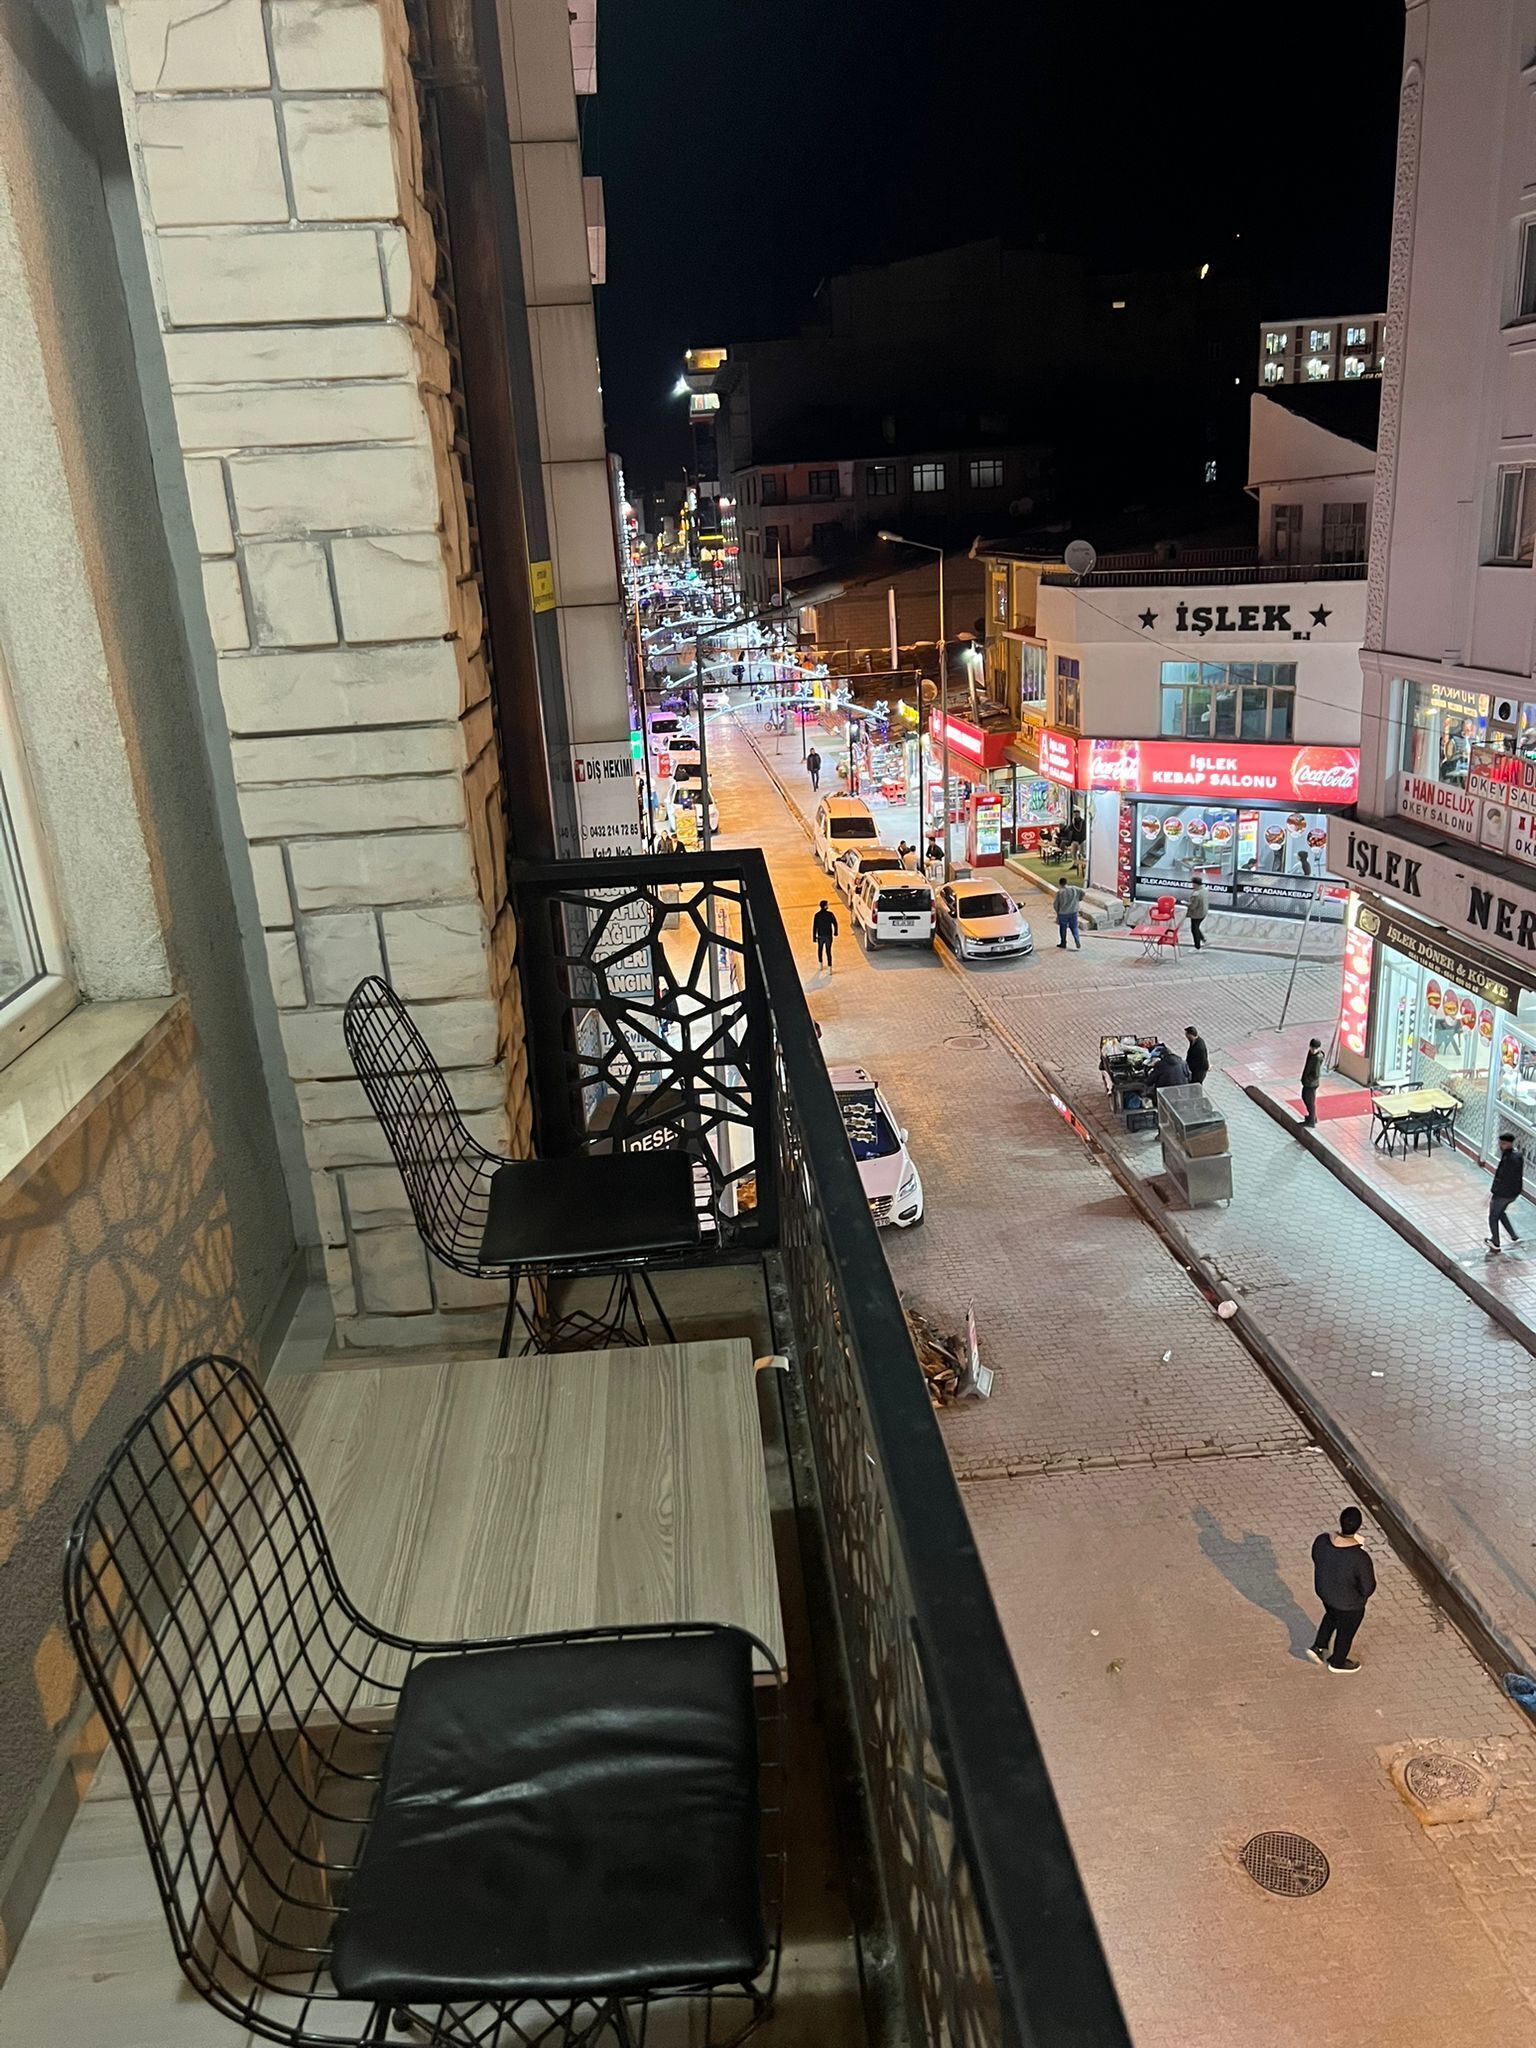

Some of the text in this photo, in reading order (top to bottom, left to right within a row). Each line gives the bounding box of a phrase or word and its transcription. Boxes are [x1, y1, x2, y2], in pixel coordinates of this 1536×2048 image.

[1176, 601, 1292, 637] İŞLEK
[1152, 771, 1277, 789] KEBAP SALONU
[1189, 753, 1238, 772] İŞLEK
[1412, 778, 1475, 818] HAN DELUX
[1470, 776, 1507, 798] OKEY
[589, 825, 606, 838] 0432
[607, 824, 620, 836] 214
[1402, 799, 1473, 834] OKEY SALONU
[1346, 831, 1422, 897] İŞLEK
[1386, 923, 1417, 951] İŞLEK
[1417, 943, 1456, 972] DÖNER
[1456, 963, 1467, 977] &
[1467, 968, 1509, 999] KÖFTE
